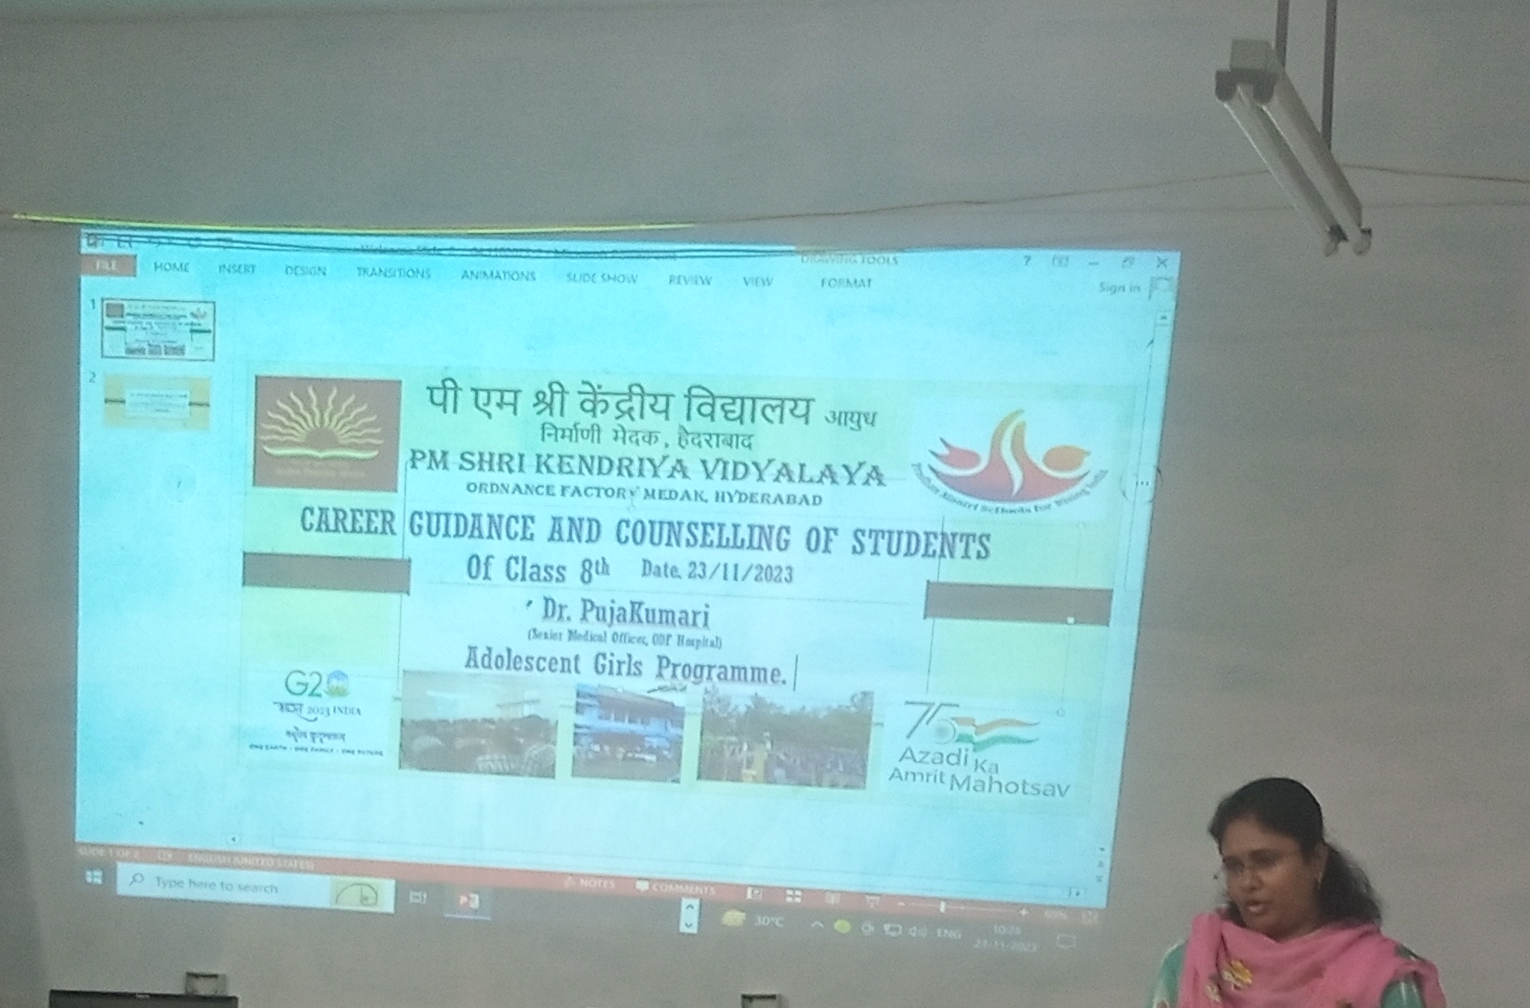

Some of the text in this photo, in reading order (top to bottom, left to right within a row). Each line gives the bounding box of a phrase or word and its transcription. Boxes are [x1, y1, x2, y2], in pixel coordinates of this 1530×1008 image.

[95, 261, 872, 289] FILE HOME INSERT DESIGN TRANSITIONS ANIMATIONS SLIDE SHOW REVIEW VIEW FORMAT
[861, 256, 898, 266] TOOLS
[1099, 281, 1141, 295] Sign in
[426, 377, 877, 431] पी एम श्री केंद्रीय विद्यालय आयुध
[541, 422, 601, 444] निर्माणी
[409, 449, 887, 487] PM SHRI KENDRIYA VIDYALAYA
[466, 481, 556, 497] ORDNANCE
[560, 484, 641, 500] FACTORY
[714, 489, 824, 507] HYDERABAD
[300, 506, 992, 560] CAREER GUIDANCE AND COUNSELLING OF STUDENTS
[466, 554, 495, 581] Of
[505, 555, 567, 584] Class
[580, 556, 610, 585] 8th
[687, 561, 794, 584] 23/11/2023
[542, 595, 710, 629] Dr. PujaKumari
[464, 644, 786, 685] Adolescent Girls Programme.
[898, 745, 999, 775] Azadi Ka
[888, 766, 1071, 798] Amrit Mahotsav
[155, 876, 278, 894] Type here to search
[579, 877, 616, 889] NOTES
[652, 881, 716, 896] COMMENTS
